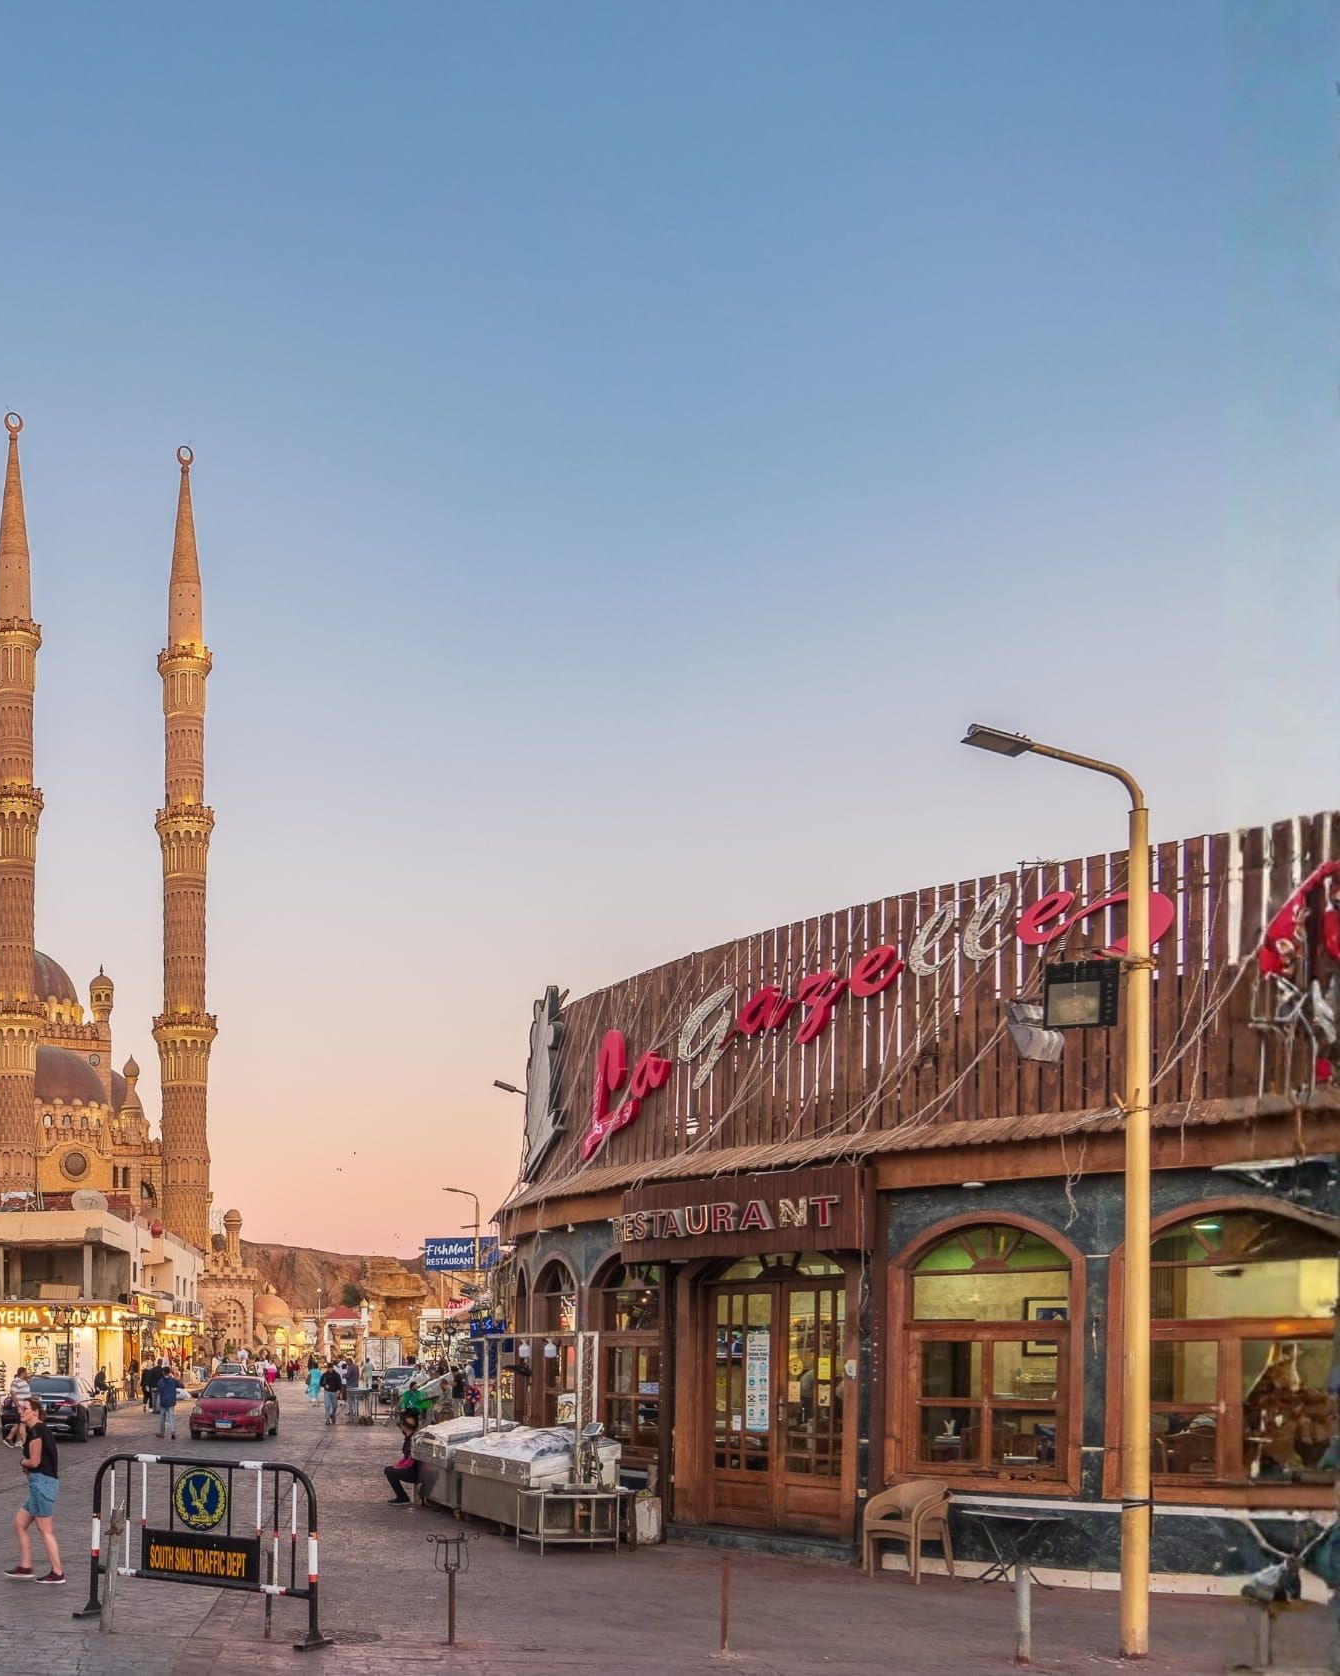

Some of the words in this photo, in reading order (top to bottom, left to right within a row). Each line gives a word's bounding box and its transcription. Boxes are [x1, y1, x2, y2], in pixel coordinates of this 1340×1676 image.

[581, 1029, 672, 1161] La
[611, 1195, 841, 1243] RESTAURANT
[426, 1257, 475, 1266] RESTAURANT
[149, 1544, 174, 1570] SOUTH
[175, 1547, 194, 1572] SINAI
[194, 1549, 225, 1575] TRAFFIC
[226, 1552, 247, 1578] DEPT
